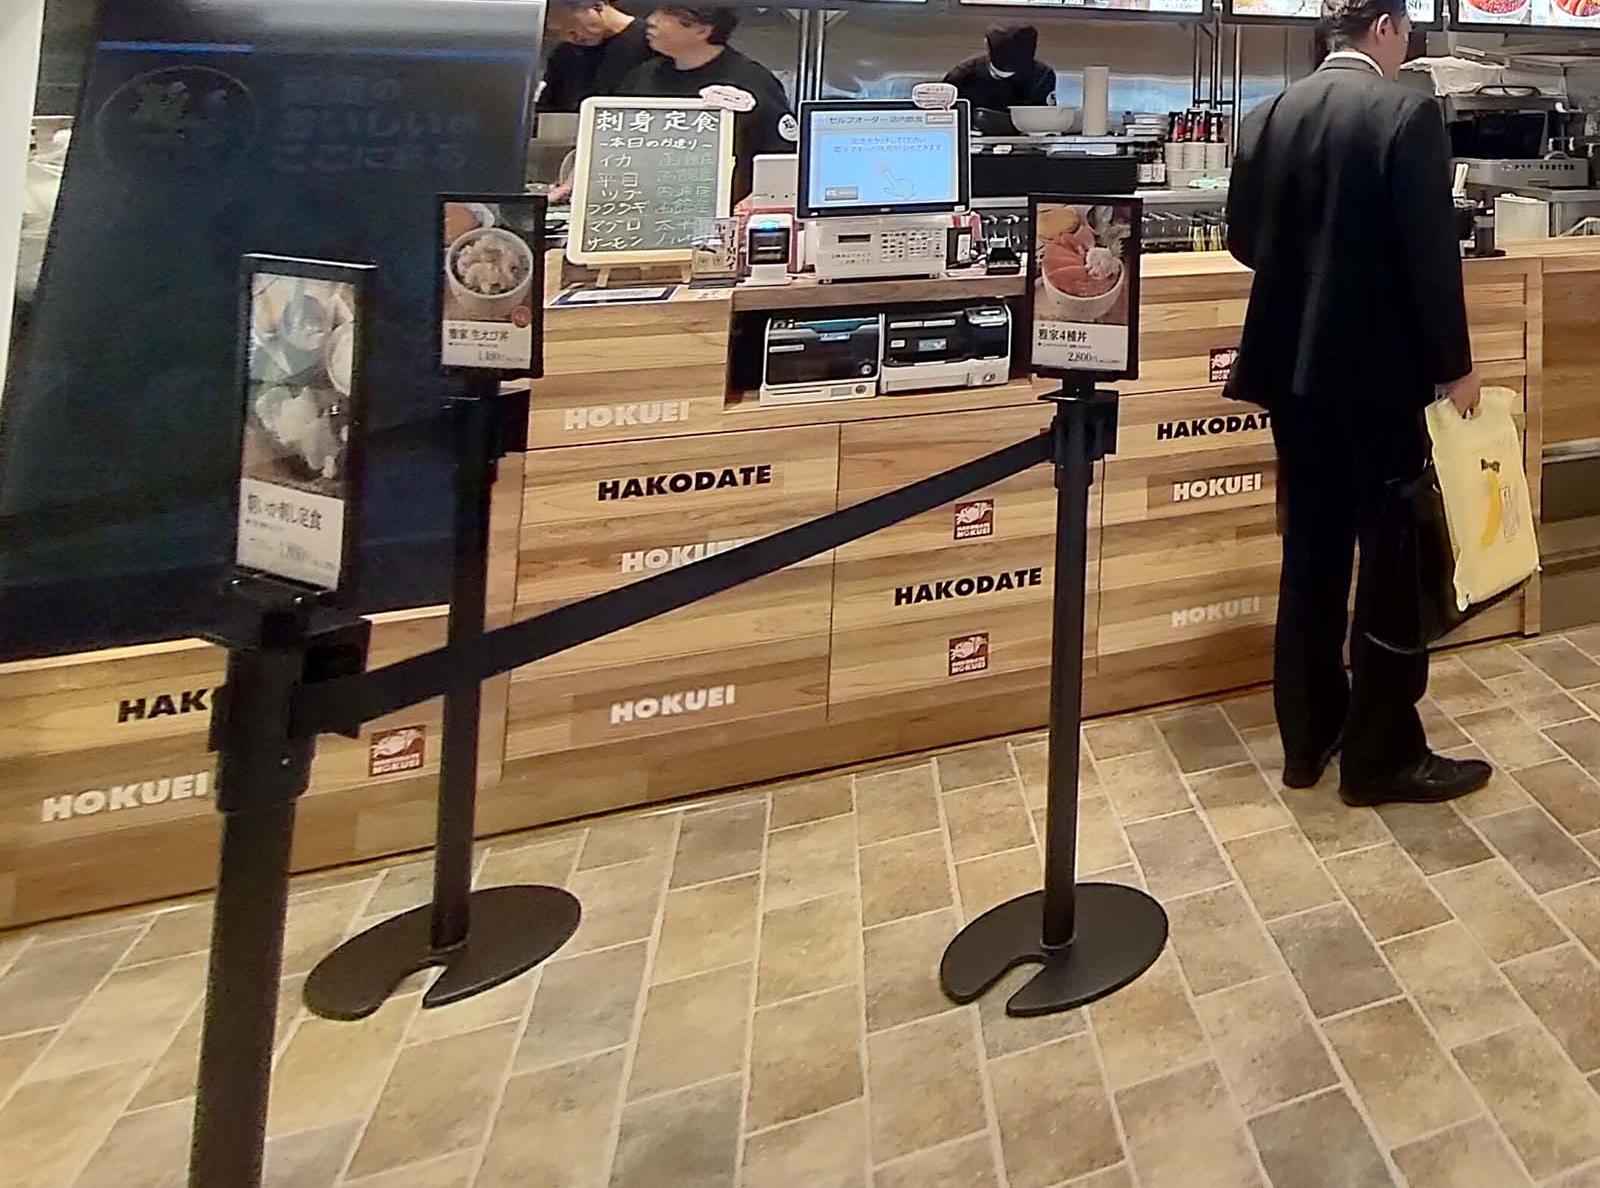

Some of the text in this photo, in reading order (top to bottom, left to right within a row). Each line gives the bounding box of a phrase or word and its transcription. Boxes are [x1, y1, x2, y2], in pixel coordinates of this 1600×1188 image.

[596, 110, 720, 133] 刺身定食
[600, 154, 632, 168] イカ
[601, 190, 642, 201] ツブ
[590, 219, 642, 234] マグロ
[587, 236, 644, 251] サーモン
[563, 401, 690, 431] HOKUEI
[597, 465, 772, 501] HAKODATE
[1173, 473, 1262, 501] HOKUEI
[893, 567, 1042, 606] HAKODATE
[1171, 596, 1260, 627] HOKUEI
[611, 685, 735, 724] HOKUEI
[41, 771, 209, 823] HOKUEI
